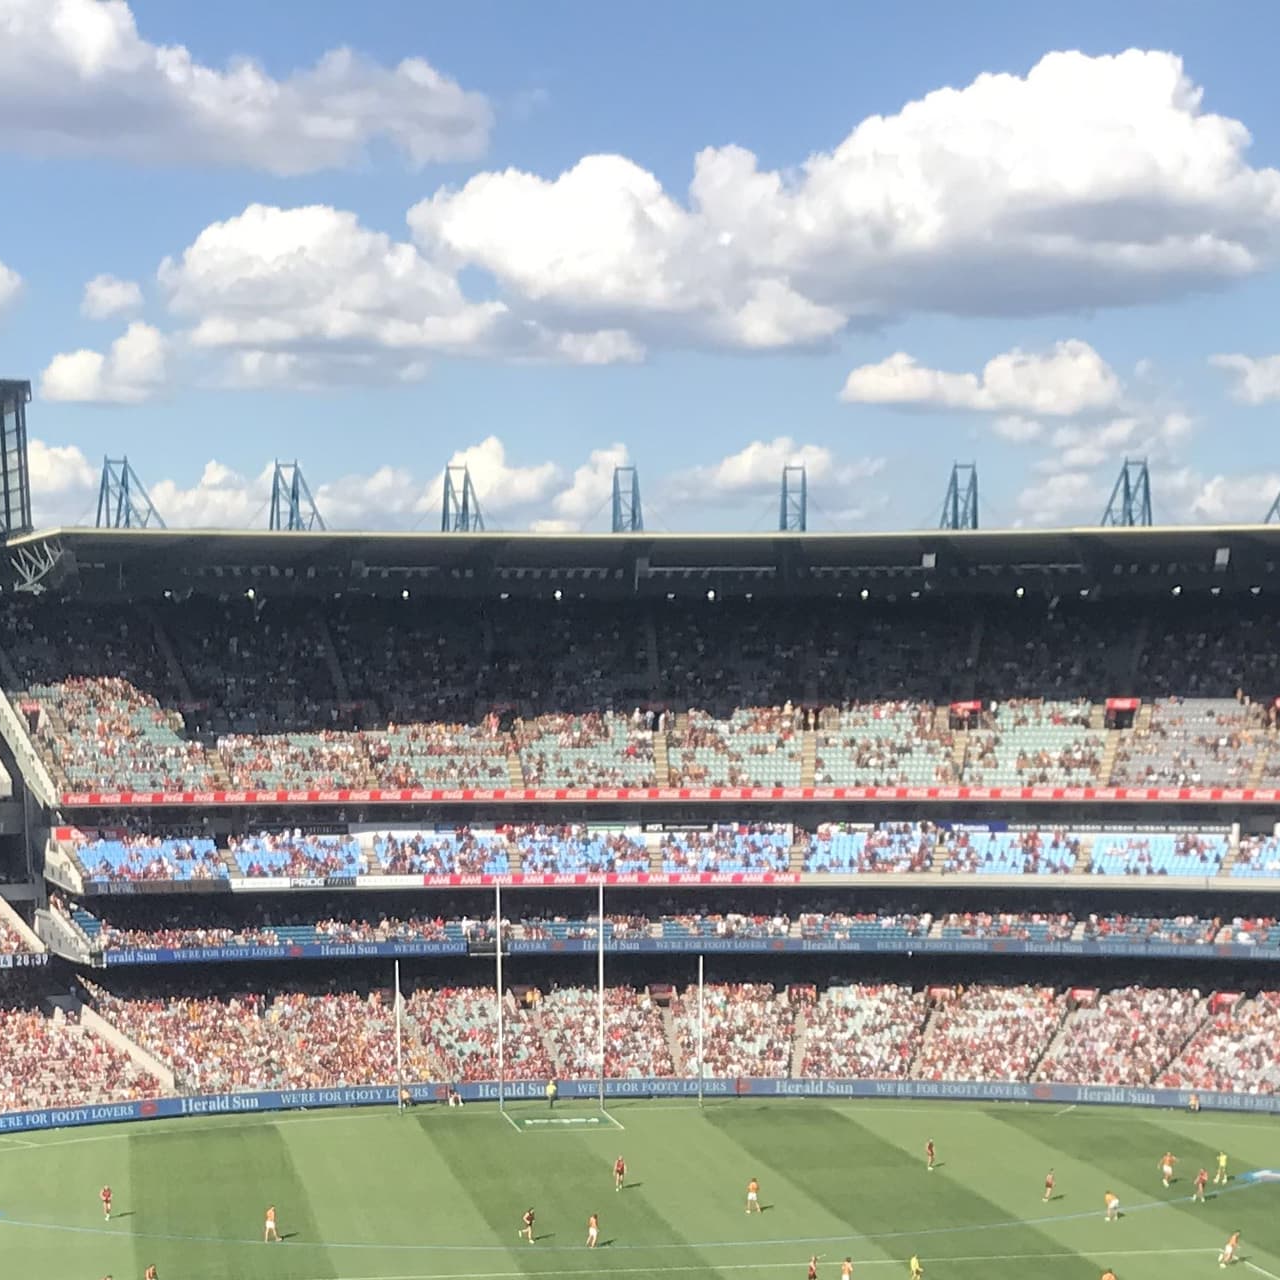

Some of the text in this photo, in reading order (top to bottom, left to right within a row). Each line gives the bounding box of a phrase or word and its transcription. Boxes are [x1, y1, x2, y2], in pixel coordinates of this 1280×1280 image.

[614, 1081, 679, 1092] FOR FOOTY
[775, 1081, 854, 1093] Herald Sun
[280, 1088, 385, 1104] WE'RE FOR FOOTY
[181, 1095, 260, 1114] Herald Sun
[25, 1112, 48, 1125] FOR
[51, 1109, 90, 1123] FOOTY
[91, 1105, 135, 1120] LOVERS
